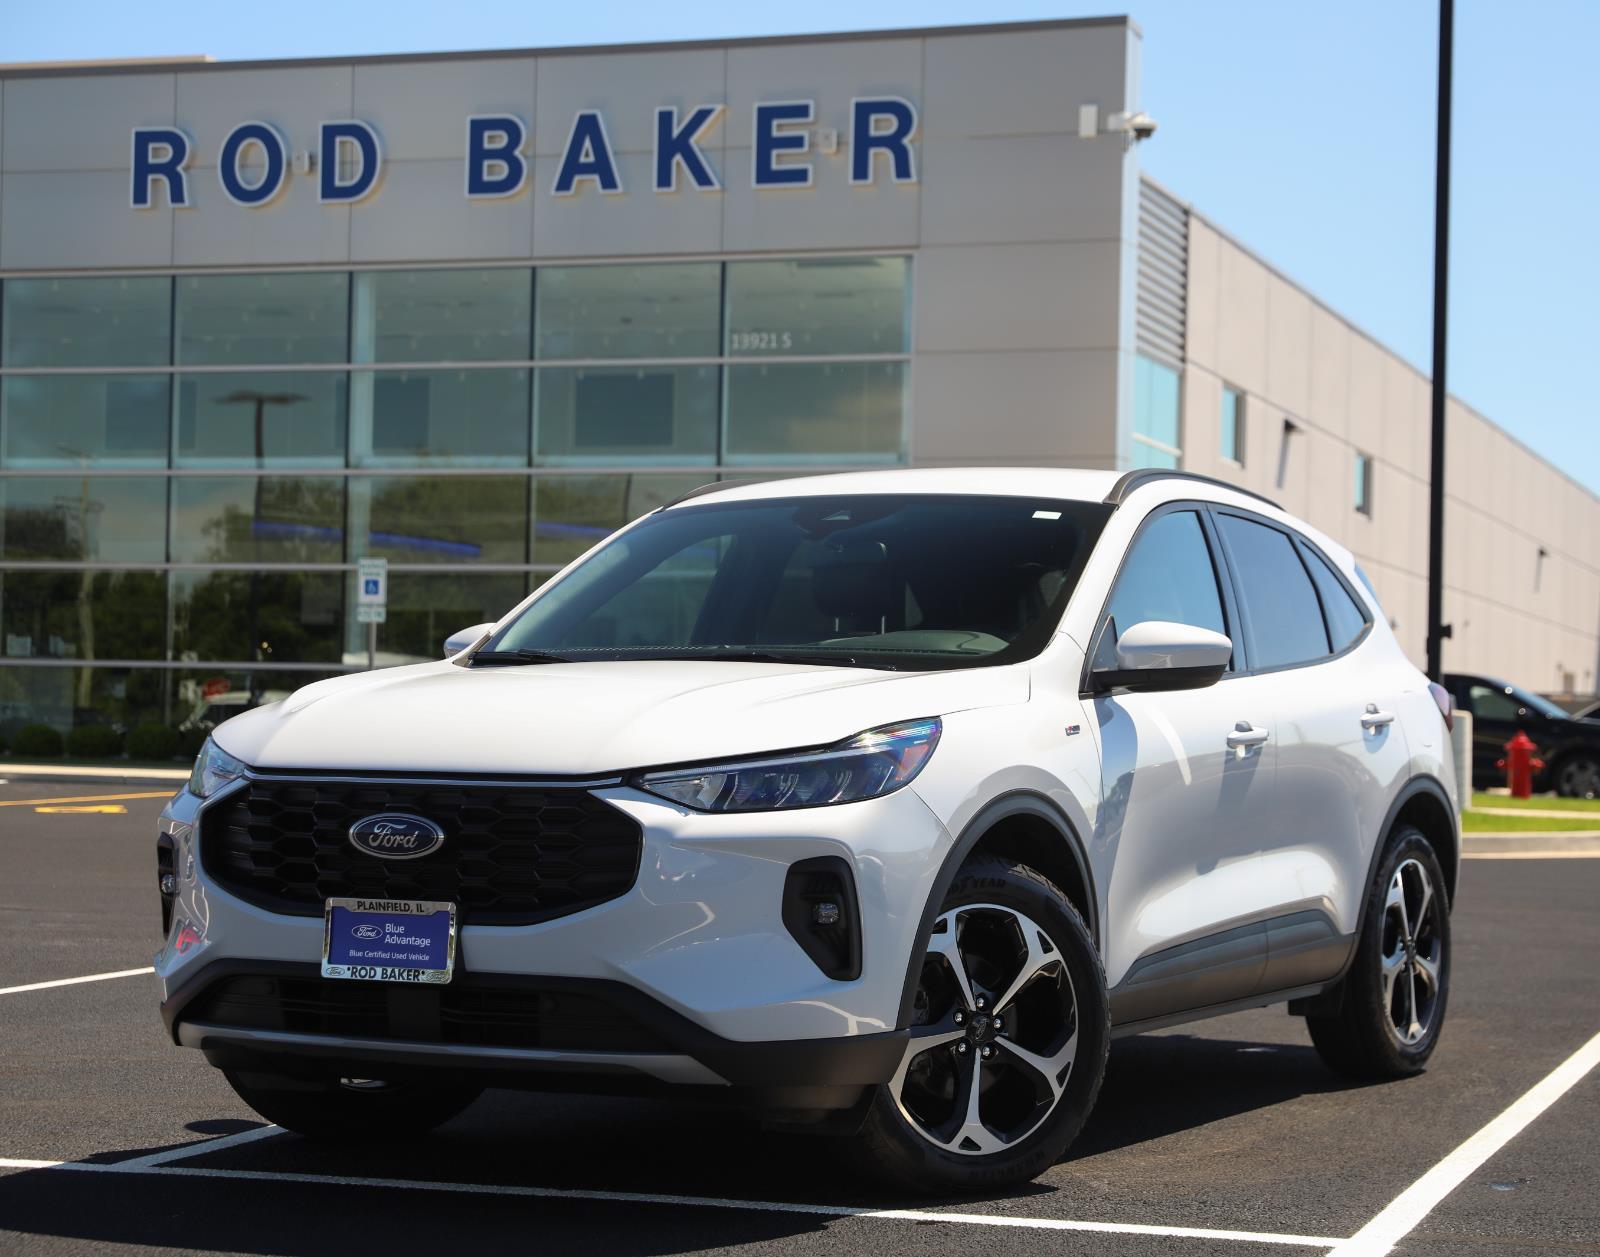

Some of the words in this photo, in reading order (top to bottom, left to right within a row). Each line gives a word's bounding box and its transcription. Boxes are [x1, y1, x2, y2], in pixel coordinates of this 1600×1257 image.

[130, 118, 384, 210] ROD
[465, 95, 919, 199] BAKER
[369, 822, 420, 848] Ford
[356, 900, 412, 913] PLAINFIELD,
[416, 903, 425, 913] IL
[357, 926, 377, 938] Ford
[385, 923, 405, 934] Blue
[384, 935, 431, 947] Advantage
[349, 949, 363, 957] Blue
[364, 950, 391, 959] Certified
[391, 951, 408, 960] Used
[408, 952, 430, 961] Vehicle
[350, 967, 377, 979] ROD
[381, 968, 421, 981] BAKER
